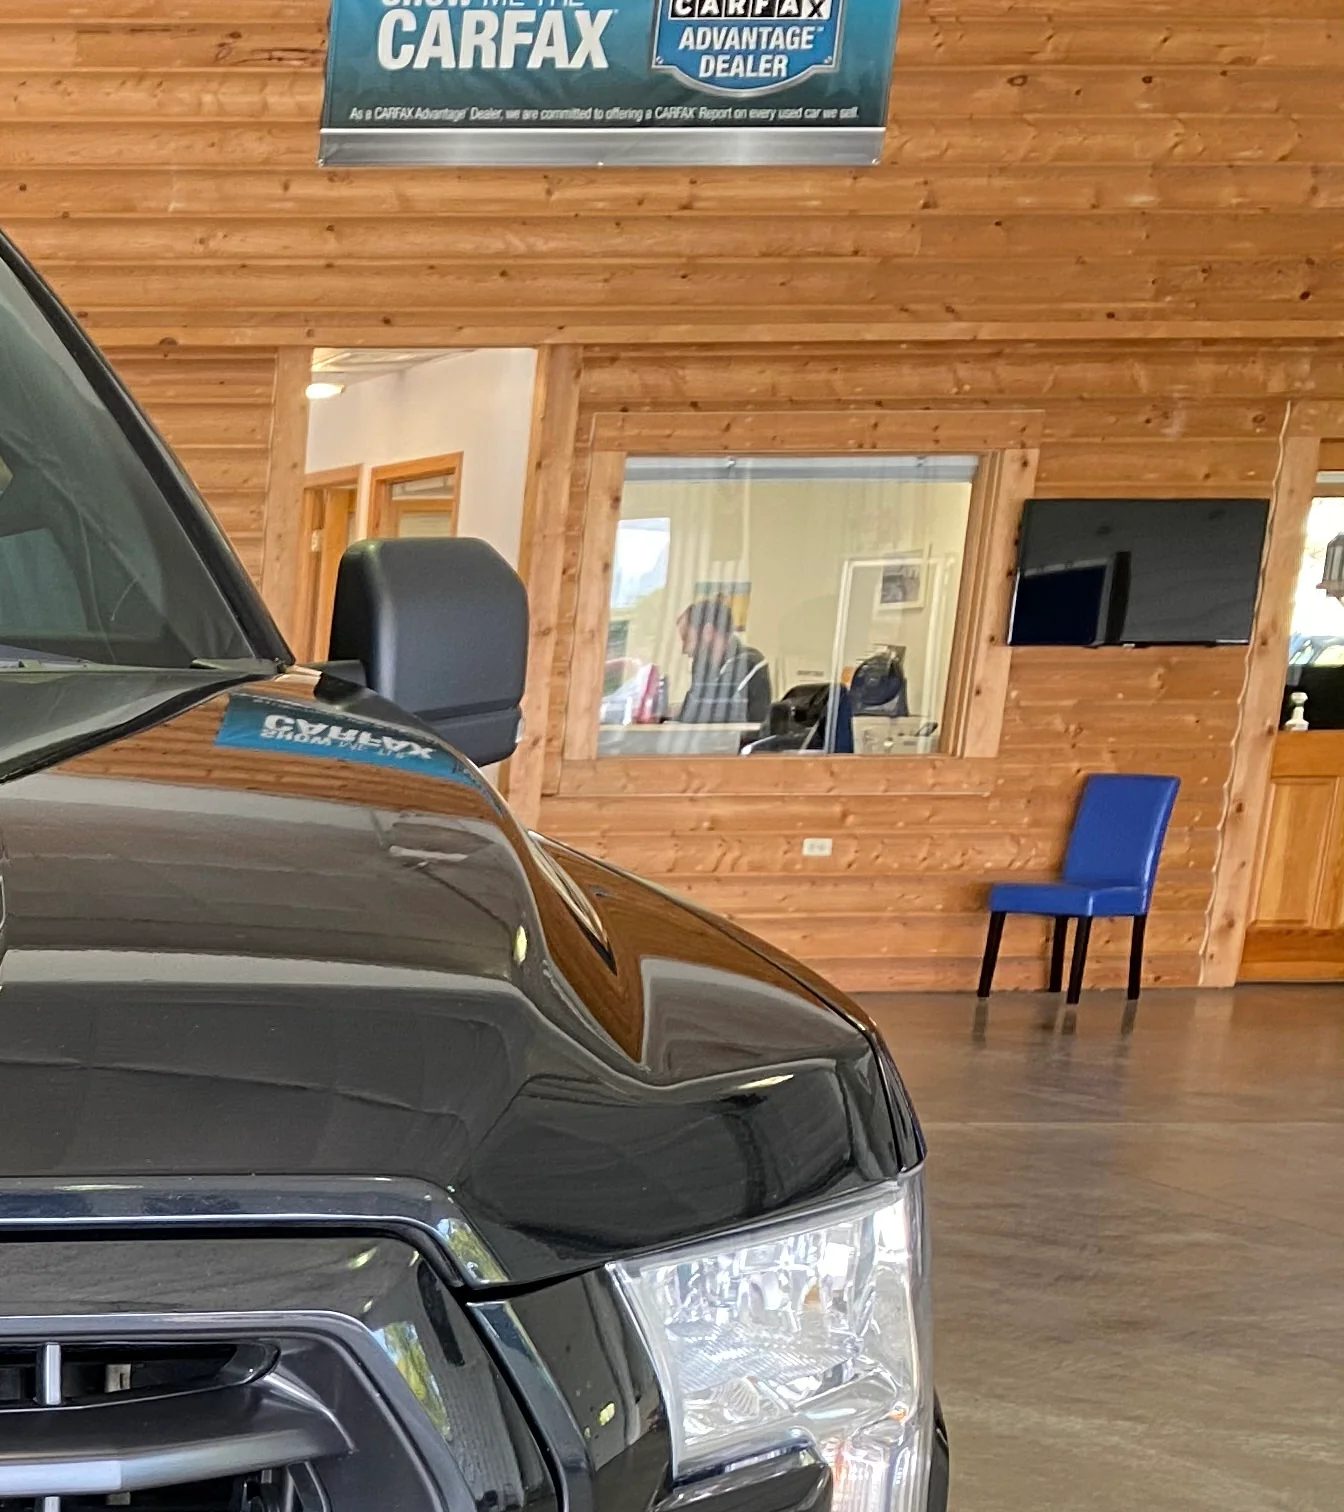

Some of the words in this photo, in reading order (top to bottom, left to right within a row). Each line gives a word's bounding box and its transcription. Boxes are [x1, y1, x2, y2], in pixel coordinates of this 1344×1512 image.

[673, 0, 825, 18] CARFAX
[378, 9, 612, 70] CARFAX
[678, 26, 816, 51] ADVANTAGE
[698, 54, 789, 78] DEALER
[350, 107, 363, 119] As
[365, 108, 373, 119] a
[374, 106, 414, 120] CARFAX
[522, 109, 538, 119] are
[540, 107, 592, 120] committed
[594, 107, 604, 119] to
[605, 106, 643, 122] offering
[655, 106, 694, 119] CARFAX
[698, 107, 732, 121] Report
[733, 109, 748, 119] on
[749, 109, 776, 121] every
[778, 107, 803, 119] used
[804, 109, 822, 119] car
